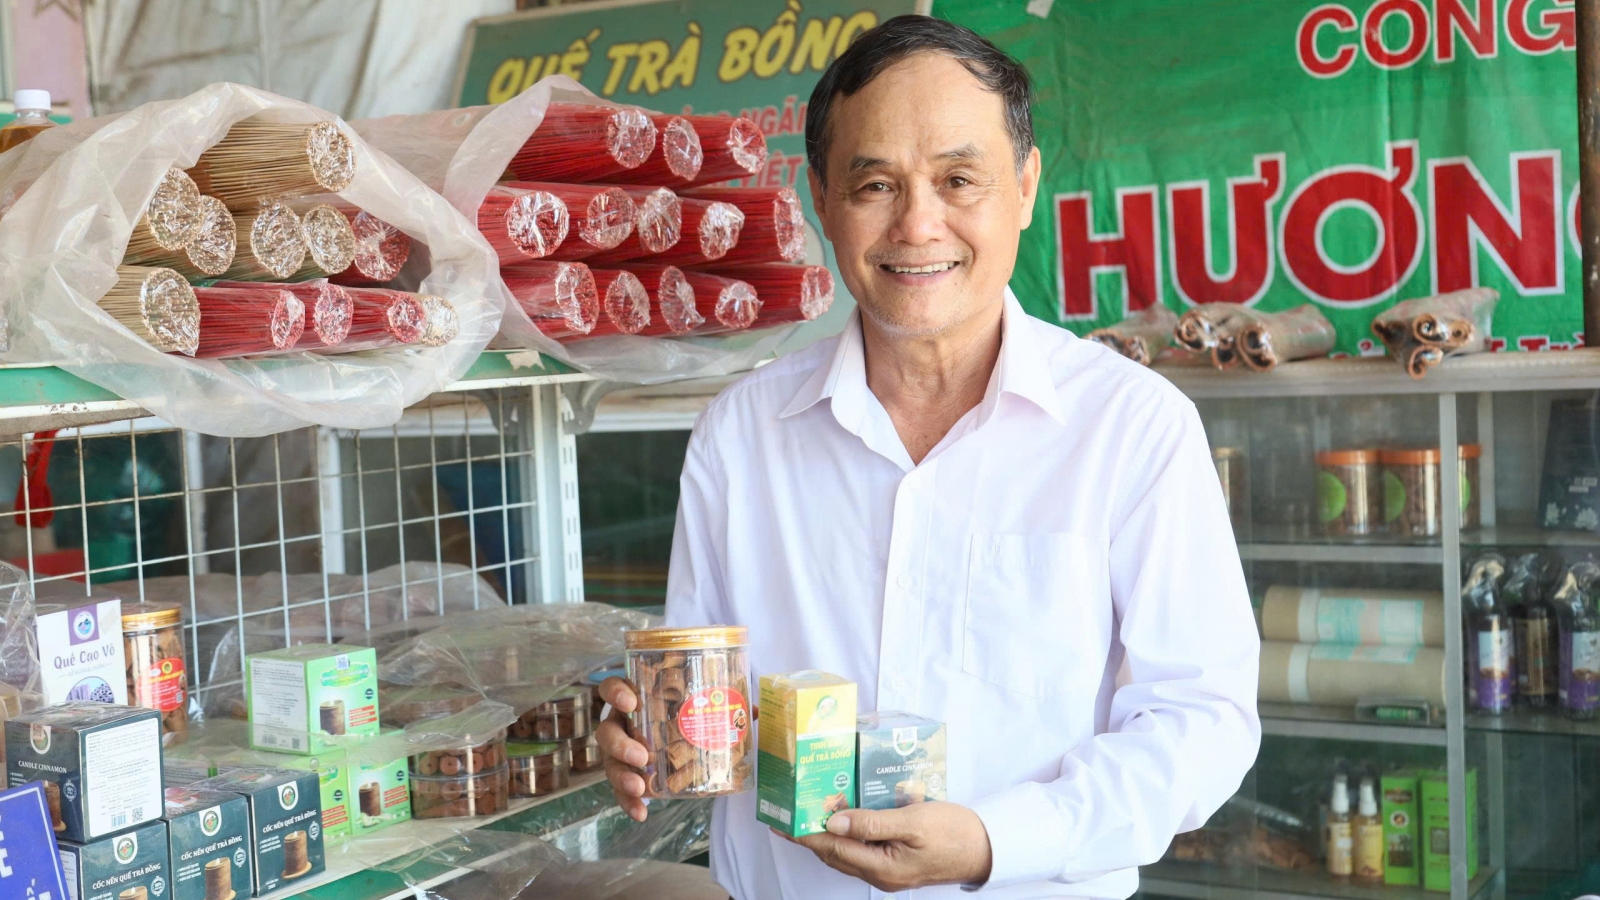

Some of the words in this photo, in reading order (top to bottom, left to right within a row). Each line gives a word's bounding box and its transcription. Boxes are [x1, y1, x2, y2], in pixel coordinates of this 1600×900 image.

[602, 20, 702, 96] TRÀ
[1054, 139, 1582, 322] HƯƠN
[18, 760, 38, 770] CANDLE
[38, 763, 67, 773] CINNAMON
[816, 751, 829, 762] TRÀ
[876, 765, 901, 774] CANDLE
[902, 762, 934, 772] CINNAMON
[181, 850, 193, 861] CỐC
[217, 841, 227, 849] TRÀ
[92, 880, 105, 890] CỐC
[119, 870, 132, 882] QUẾ
[132, 868, 145, 877] TRÀ
